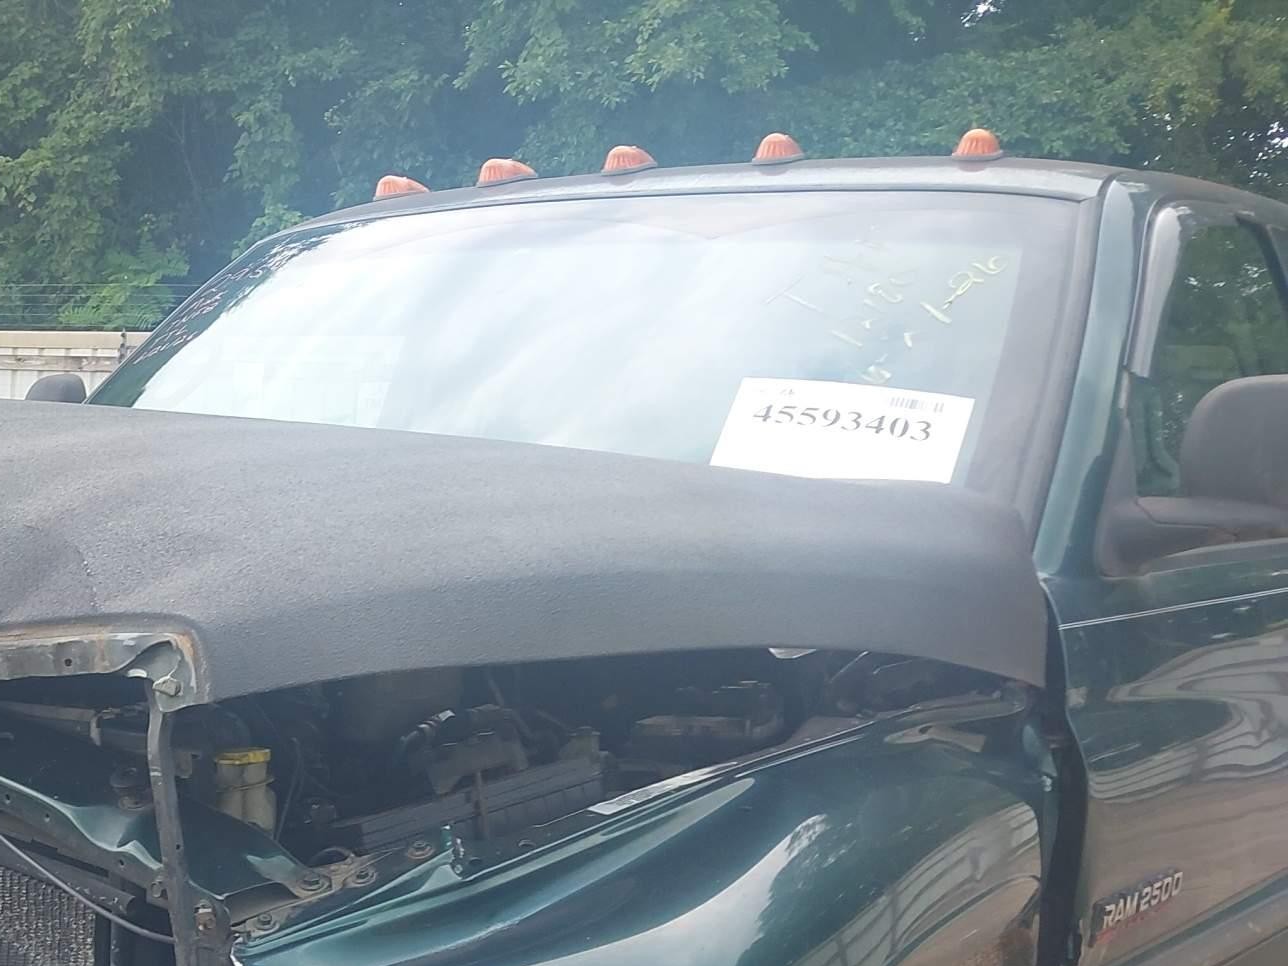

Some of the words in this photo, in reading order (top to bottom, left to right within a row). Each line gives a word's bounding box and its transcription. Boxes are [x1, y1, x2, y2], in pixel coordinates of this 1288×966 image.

[752, 403, 932, 441] 45593403
[1102, 892, 1139, 928] RAM
[1139, 872, 1183, 912] 2500
